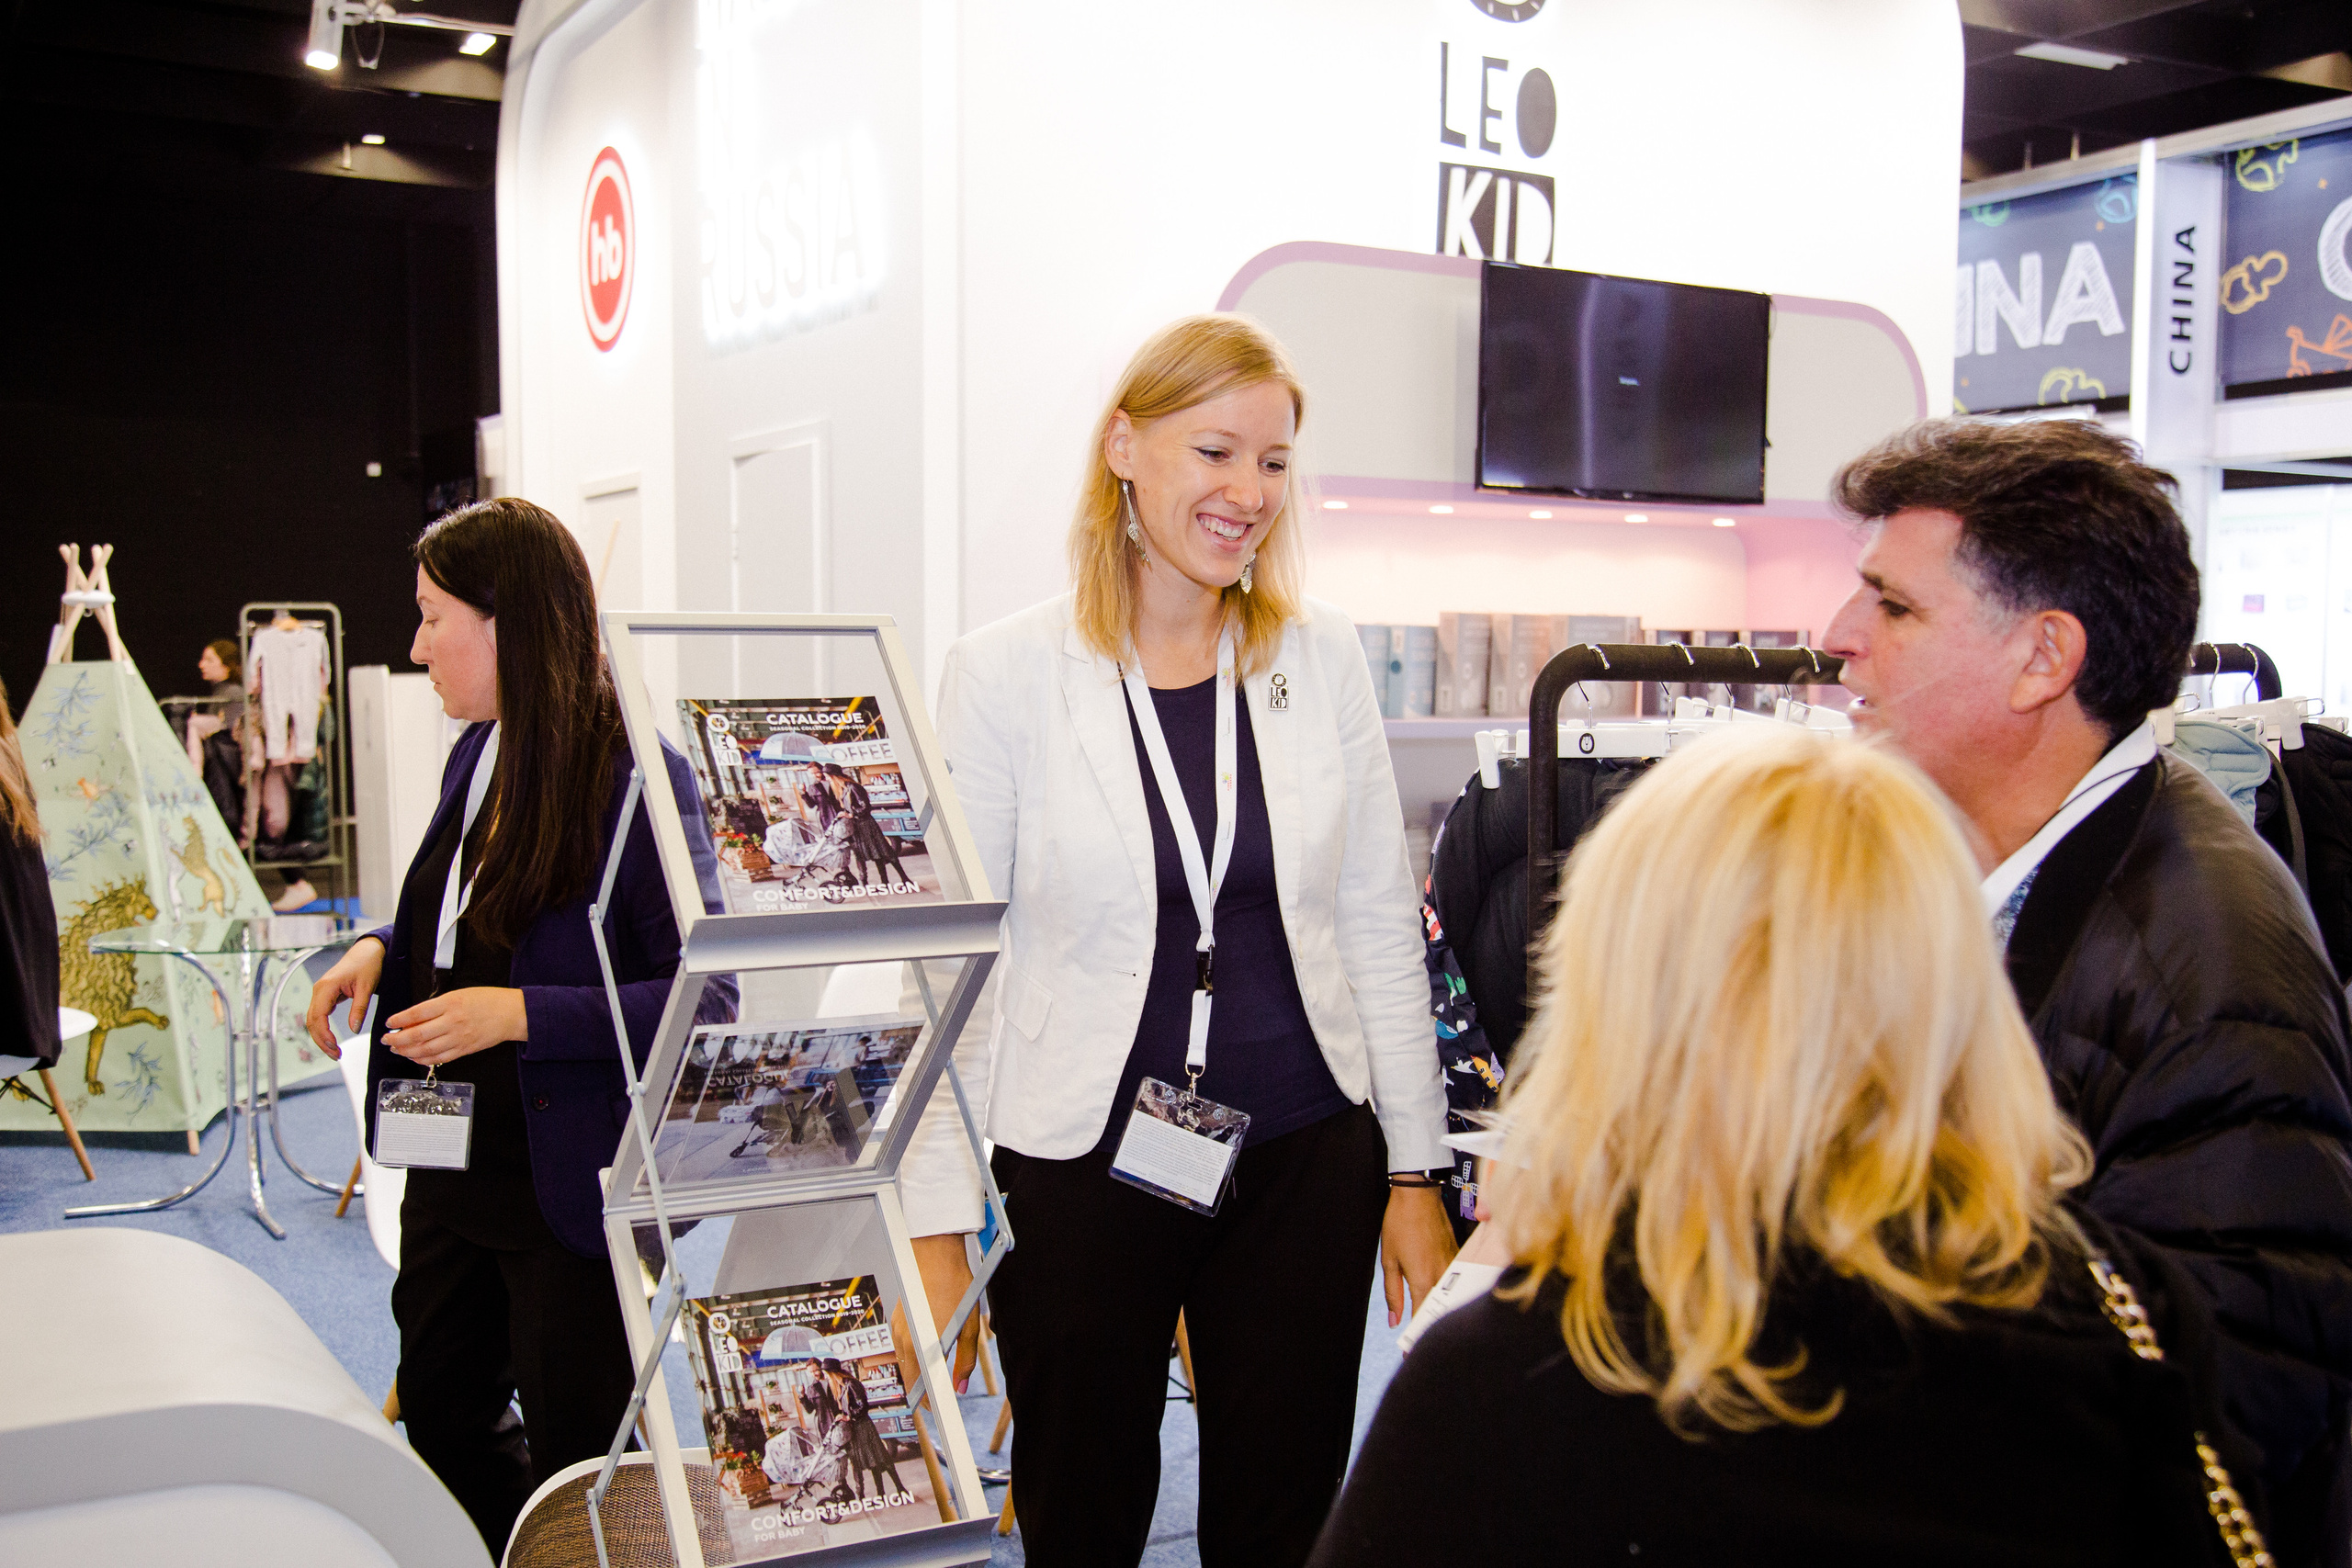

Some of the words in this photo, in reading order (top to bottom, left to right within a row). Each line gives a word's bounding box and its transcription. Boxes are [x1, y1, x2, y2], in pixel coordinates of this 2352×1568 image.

[1439, 41, 1557, 159] LEO
[1441, 164, 1554, 265] KID
[2168, 225, 2198, 377] CHINA
[1271, 687, 1287, 697] LEO
[1271, 698, 1287, 708] KID
[765, 712, 865, 726] CATALOGUE
[755, 903, 779, 911] FOR
[780, 902, 808, 911] BABY
[766, 1295, 863, 1319] CATALOGUE
[770, 1317, 800, 1326] SEASONAL
[800, 1313, 836, 1322] COLLECTION
[754, 1532, 776, 1543] FOR
[777, 1526, 806, 1540] BABY
